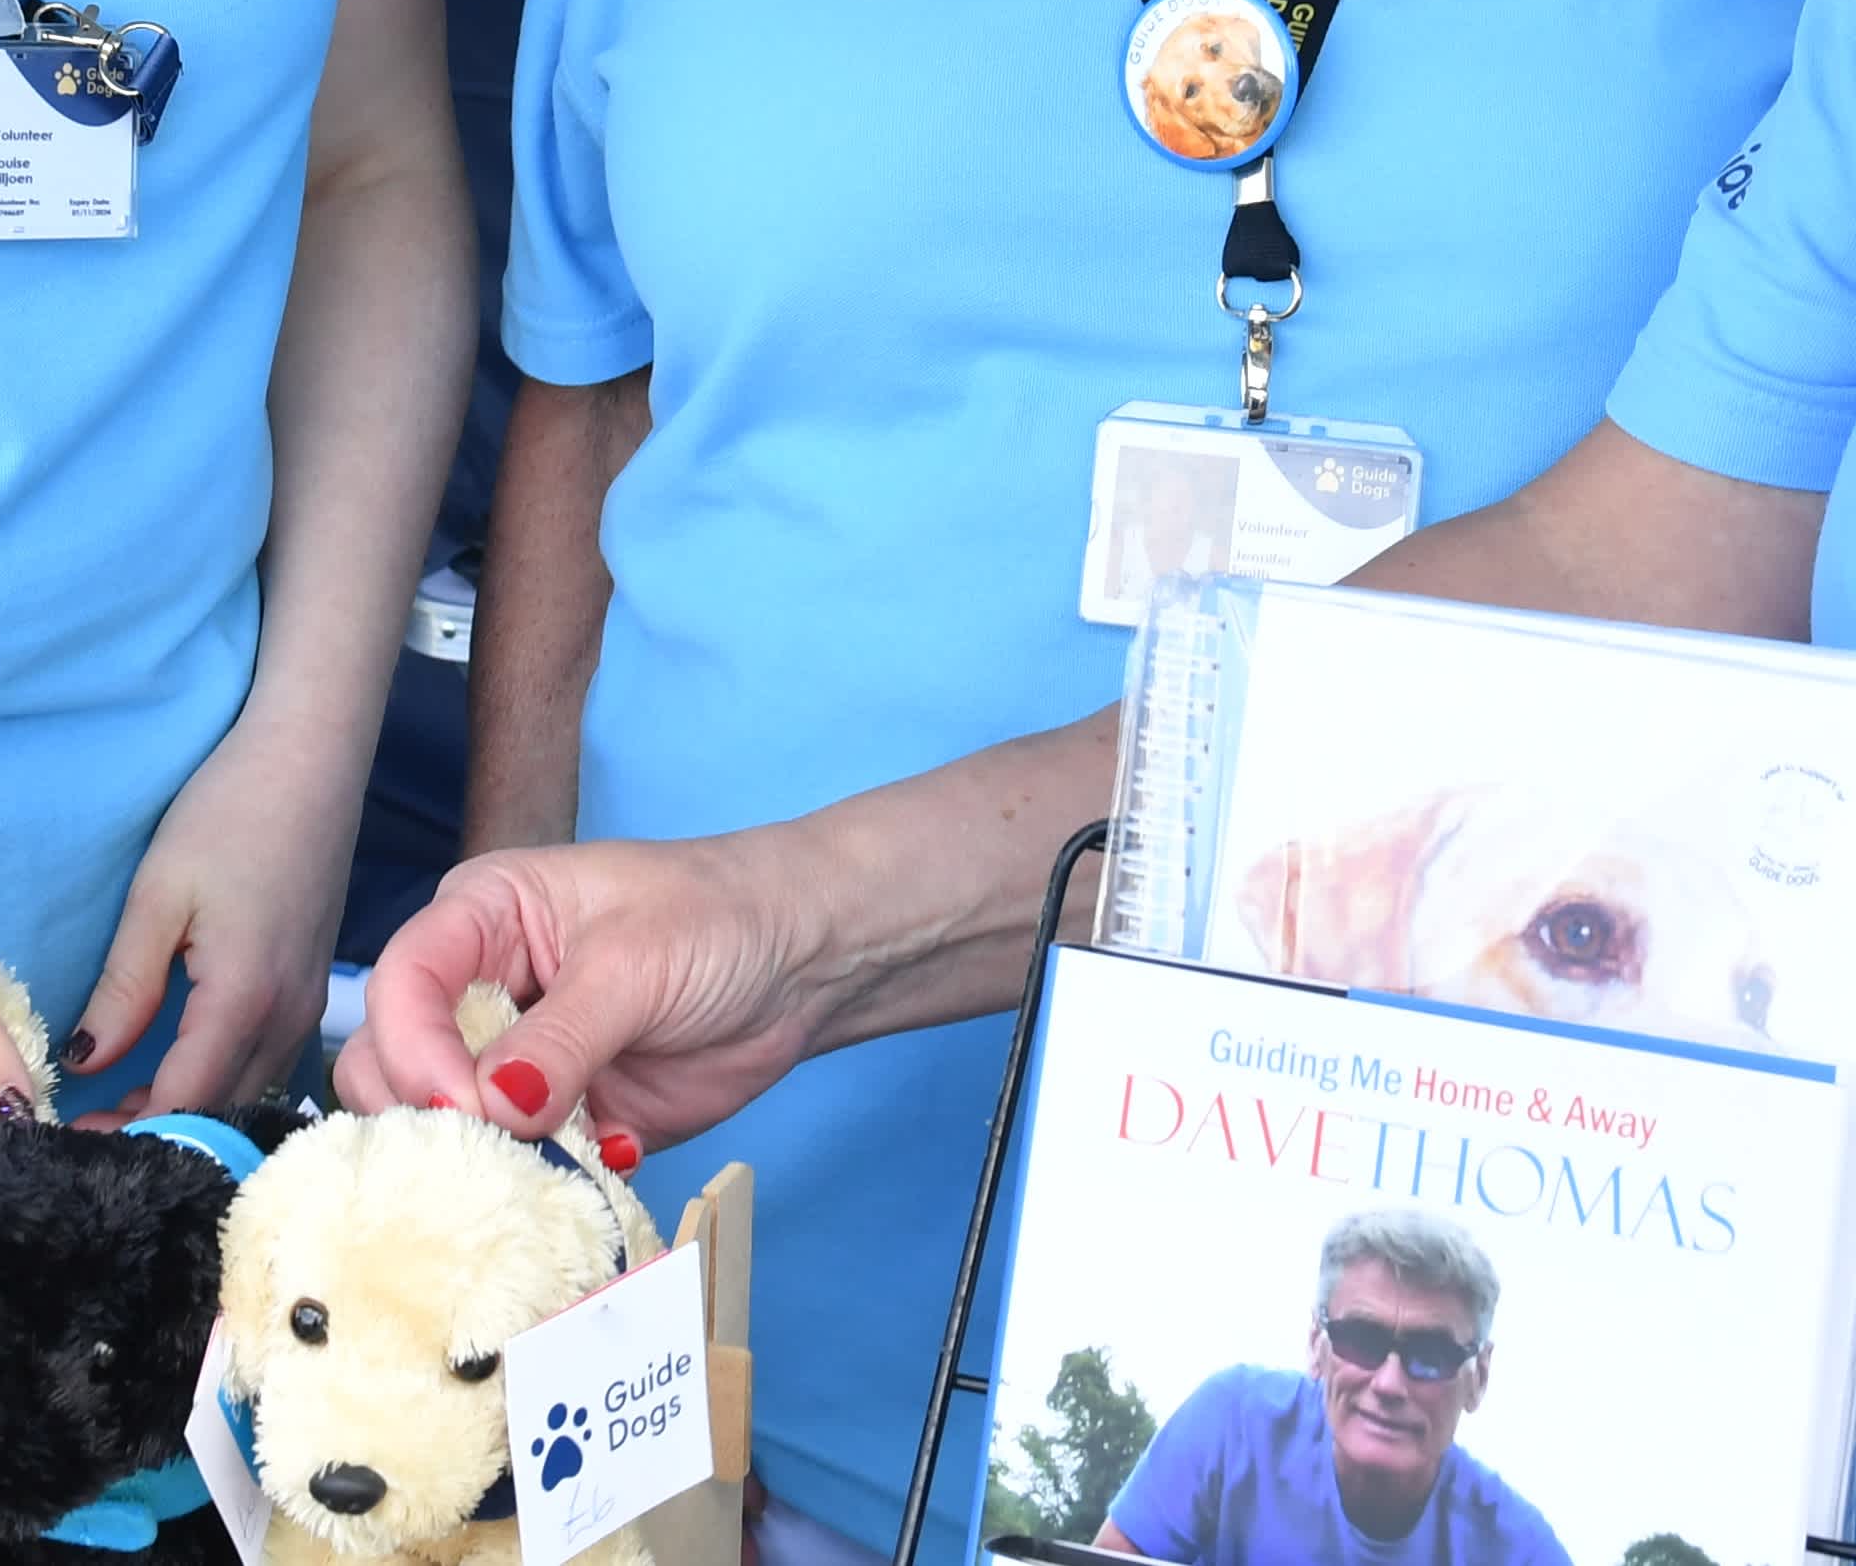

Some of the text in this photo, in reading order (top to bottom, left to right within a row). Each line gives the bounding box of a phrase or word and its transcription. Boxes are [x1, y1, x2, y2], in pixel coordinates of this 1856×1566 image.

[1351, 465, 1397, 483] Guide
[1351, 481, 1391, 499] Dogs
[1238, 520, 1309, 538] Volunteer
[1209, 1029, 1657, 1149] Guiding Me Home & Away
[605, 1351, 692, 1413] Guide
[608, 1394, 682, 1452] Dogs
